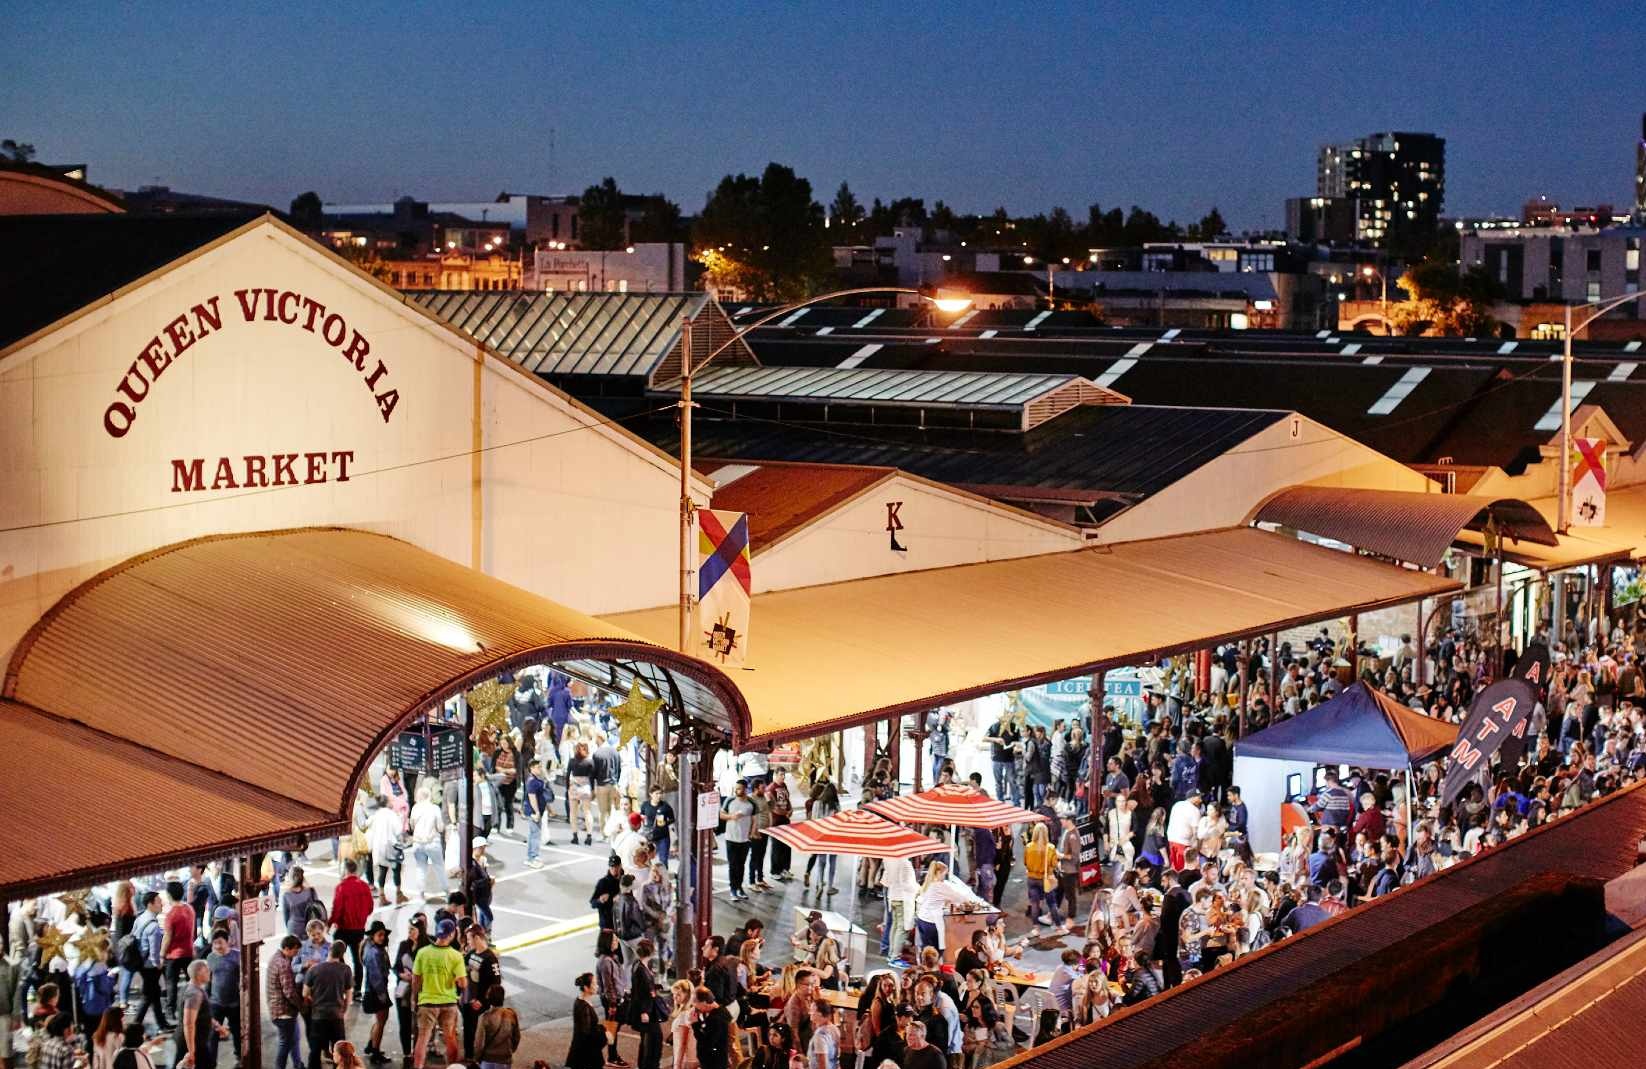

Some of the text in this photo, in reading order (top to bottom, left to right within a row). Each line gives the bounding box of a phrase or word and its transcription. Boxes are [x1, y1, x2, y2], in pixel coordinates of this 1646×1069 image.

[104, 289, 400, 438] QUEEN VICTORIA
[171, 451, 354, 492] MARKET
[1451, 697, 1518, 770] ATM
